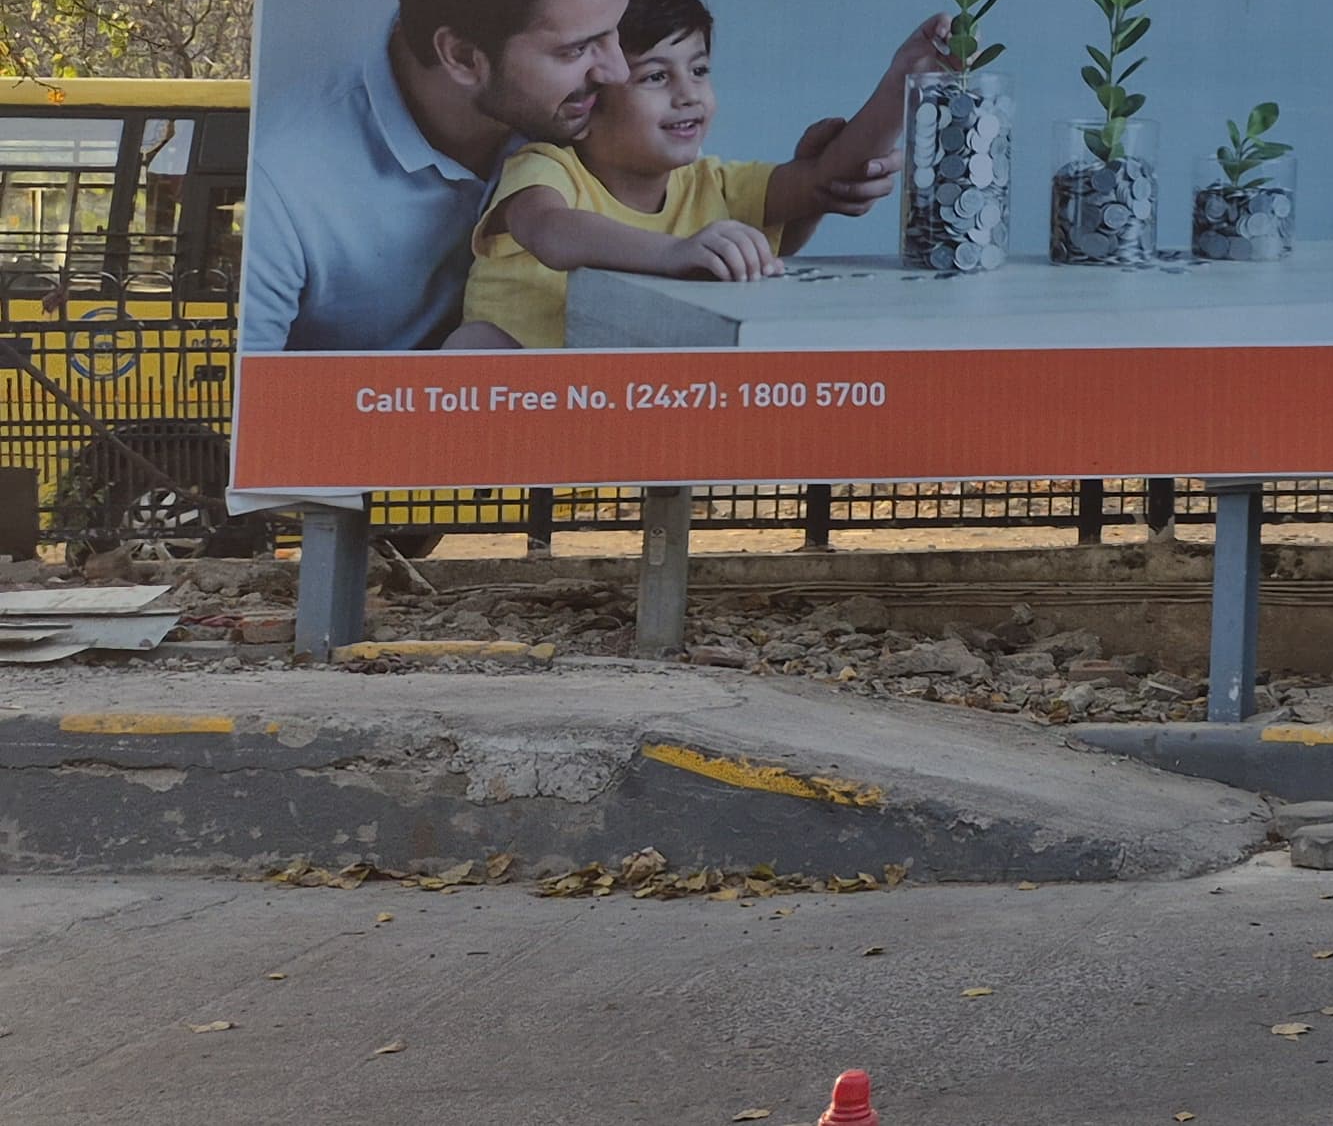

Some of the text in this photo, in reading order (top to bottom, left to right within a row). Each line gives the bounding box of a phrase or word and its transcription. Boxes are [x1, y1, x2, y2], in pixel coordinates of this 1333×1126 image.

[357, 382, 885, 412] Call Toll Free No. (24x7): 1800 5700
